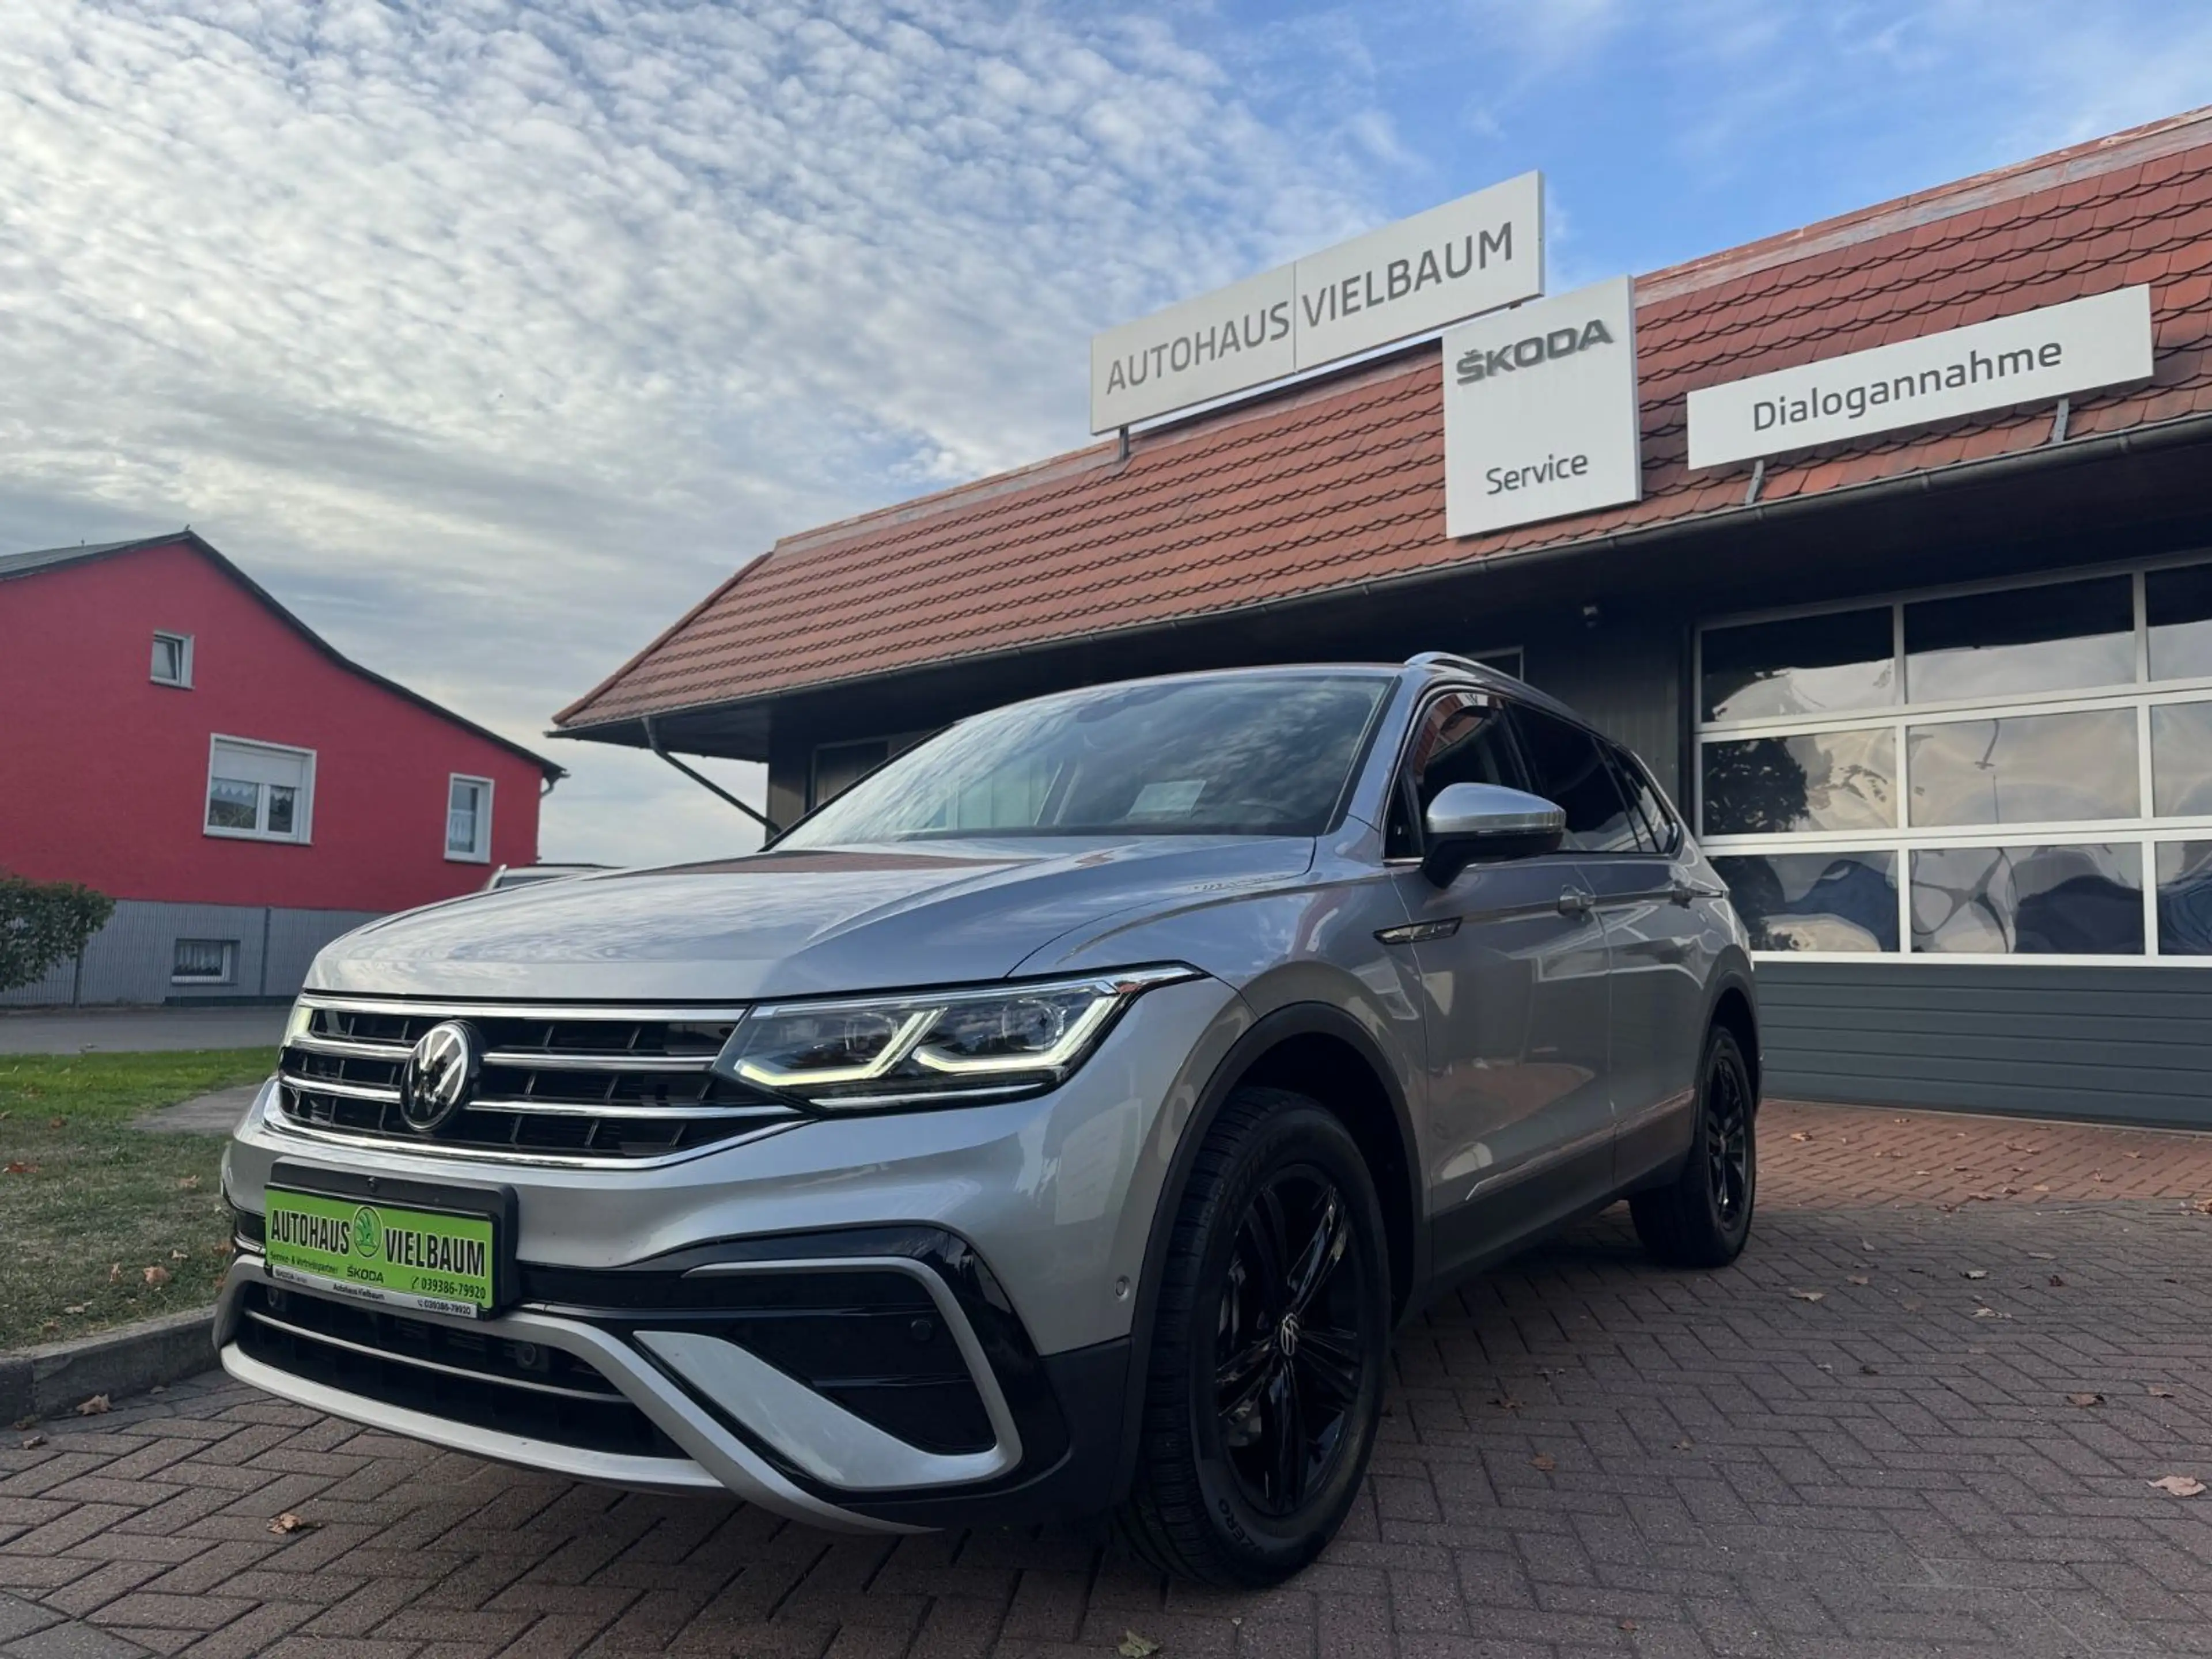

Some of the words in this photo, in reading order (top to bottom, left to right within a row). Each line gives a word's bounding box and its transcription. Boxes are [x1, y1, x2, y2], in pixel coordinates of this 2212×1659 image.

[1107, 301, 1290, 394] AUTOHAUS
[1302, 221, 1512, 327] VIELBAUM
[1457, 319, 1613, 385] ŠKODA
[1754, 342, 2062, 431] Dialogannahme
[1486, 453, 1588, 495] Service
[271, 1209, 350, 1255] AUTOHAUS
[385, 1228, 485, 1277] VIELBAUM
[347, 1264, 384, 1283] ŠKODA
[422, 1278, 485, 1299] 039386-79920
